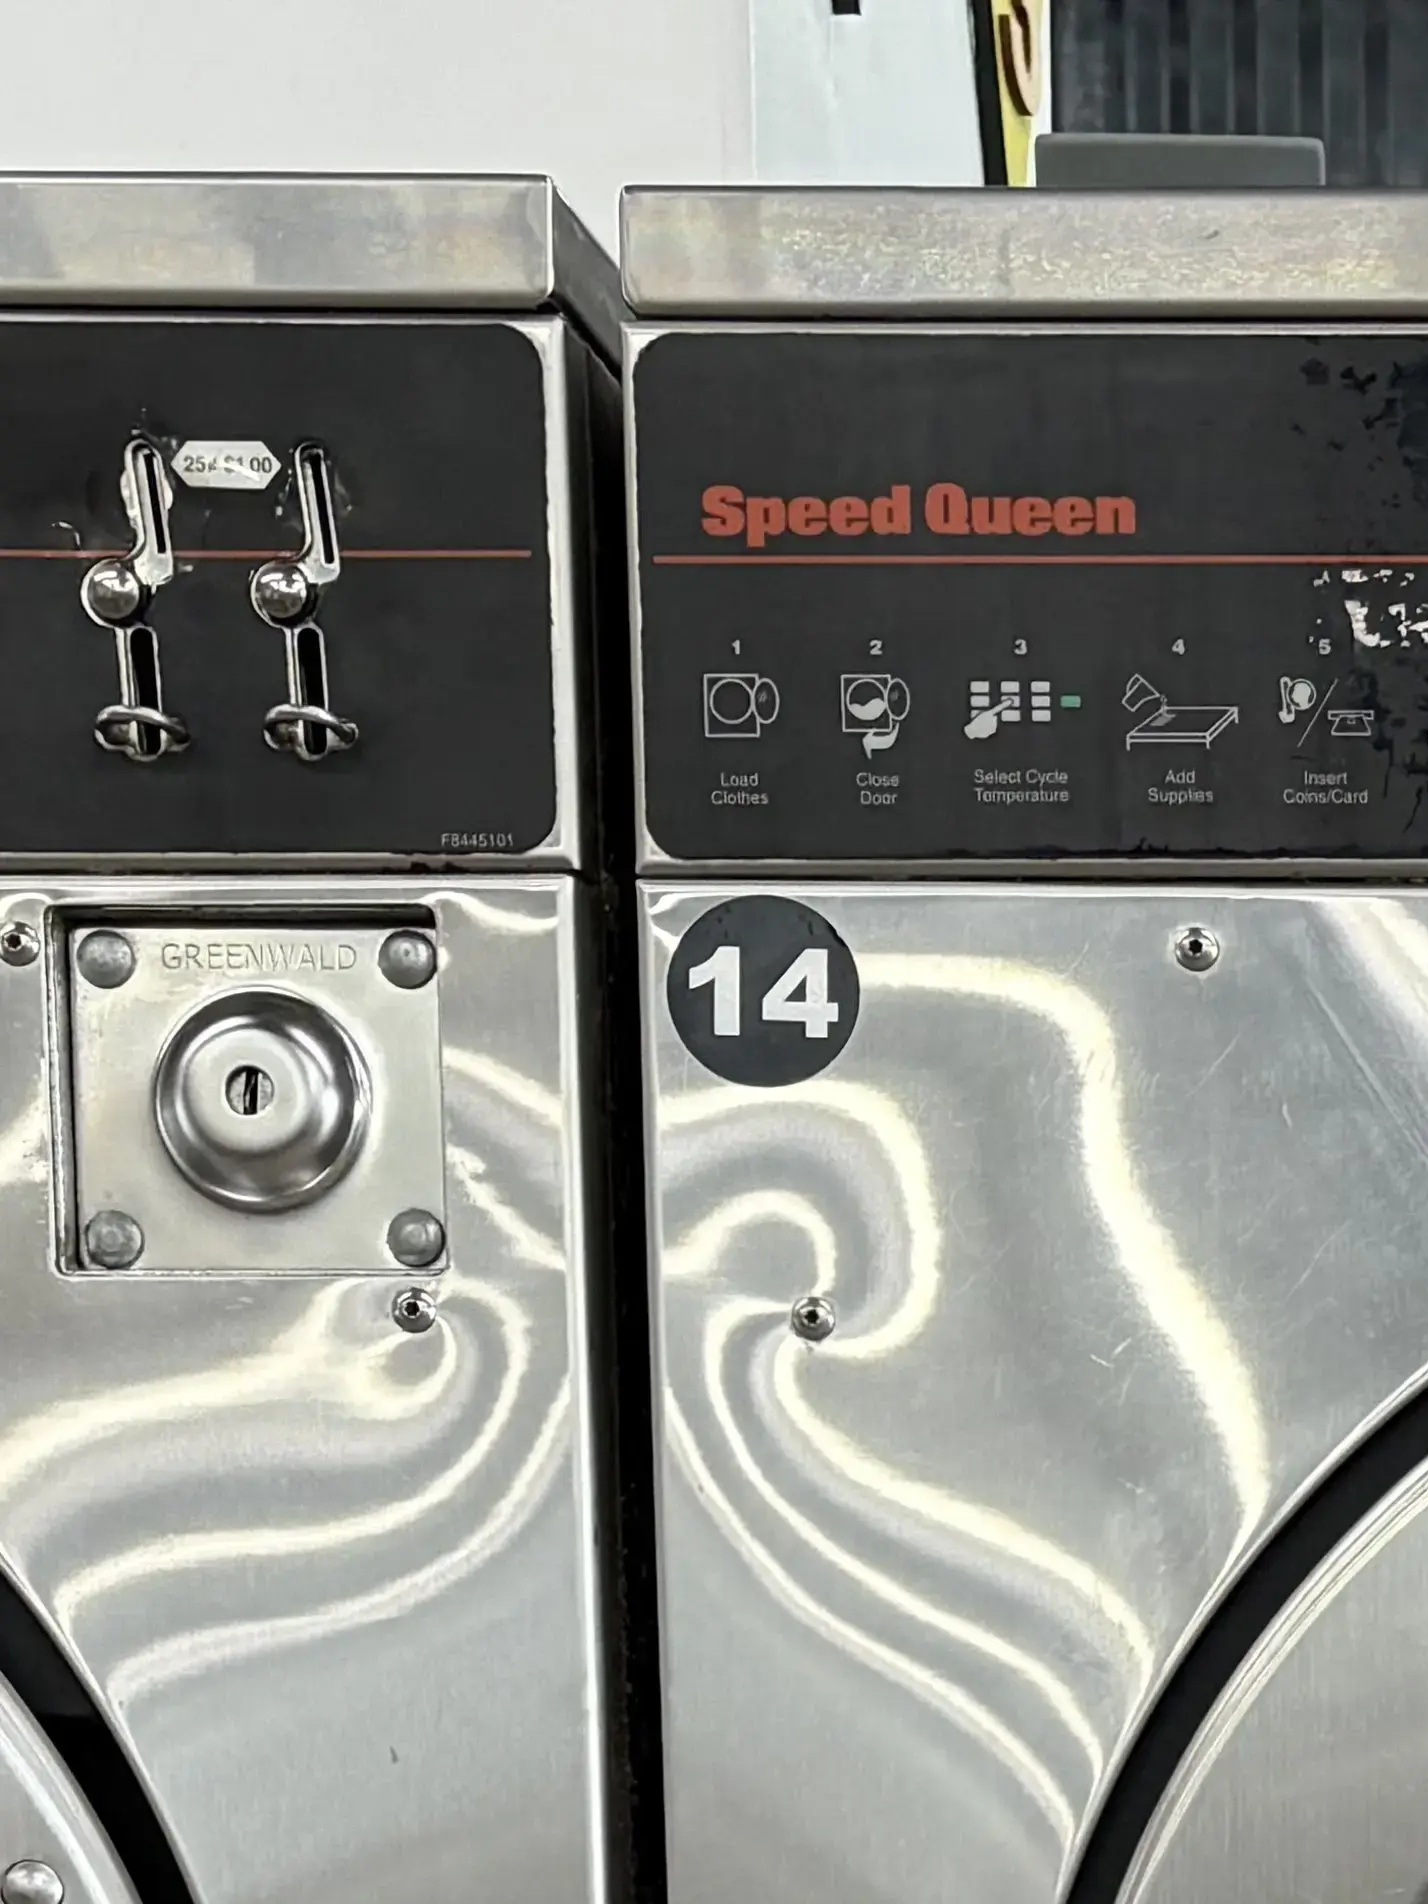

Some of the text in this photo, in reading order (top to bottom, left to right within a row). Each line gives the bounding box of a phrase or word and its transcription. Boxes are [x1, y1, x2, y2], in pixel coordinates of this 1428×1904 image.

[702, 483, 1136, 548] Speed Queen
[732, 641, 741, 655] 1
[870, 641, 882, 655] 2
[1015, 640, 1027, 655] 3
[1172, 640, 1185, 655] 4
[1319, 640, 1331, 655] 5
[720, 771, 759, 787] Load
[856, 772, 899, 787] Close
[974, 770, 1068, 787] Select Cycle
[1165, 770, 1195, 784] Add
[1303, 770, 1347, 786] Insert
[711, 790, 768, 805] Clothes
[860, 791, 897, 805] Door
[975, 787, 1069, 806] Temperature
[1149, 787, 1213, 805] Supplies
[1283, 788, 1368, 805] Coins/Card
[160, 941, 359, 973] GREENWALD
[688, 946, 840, 1038] 14
